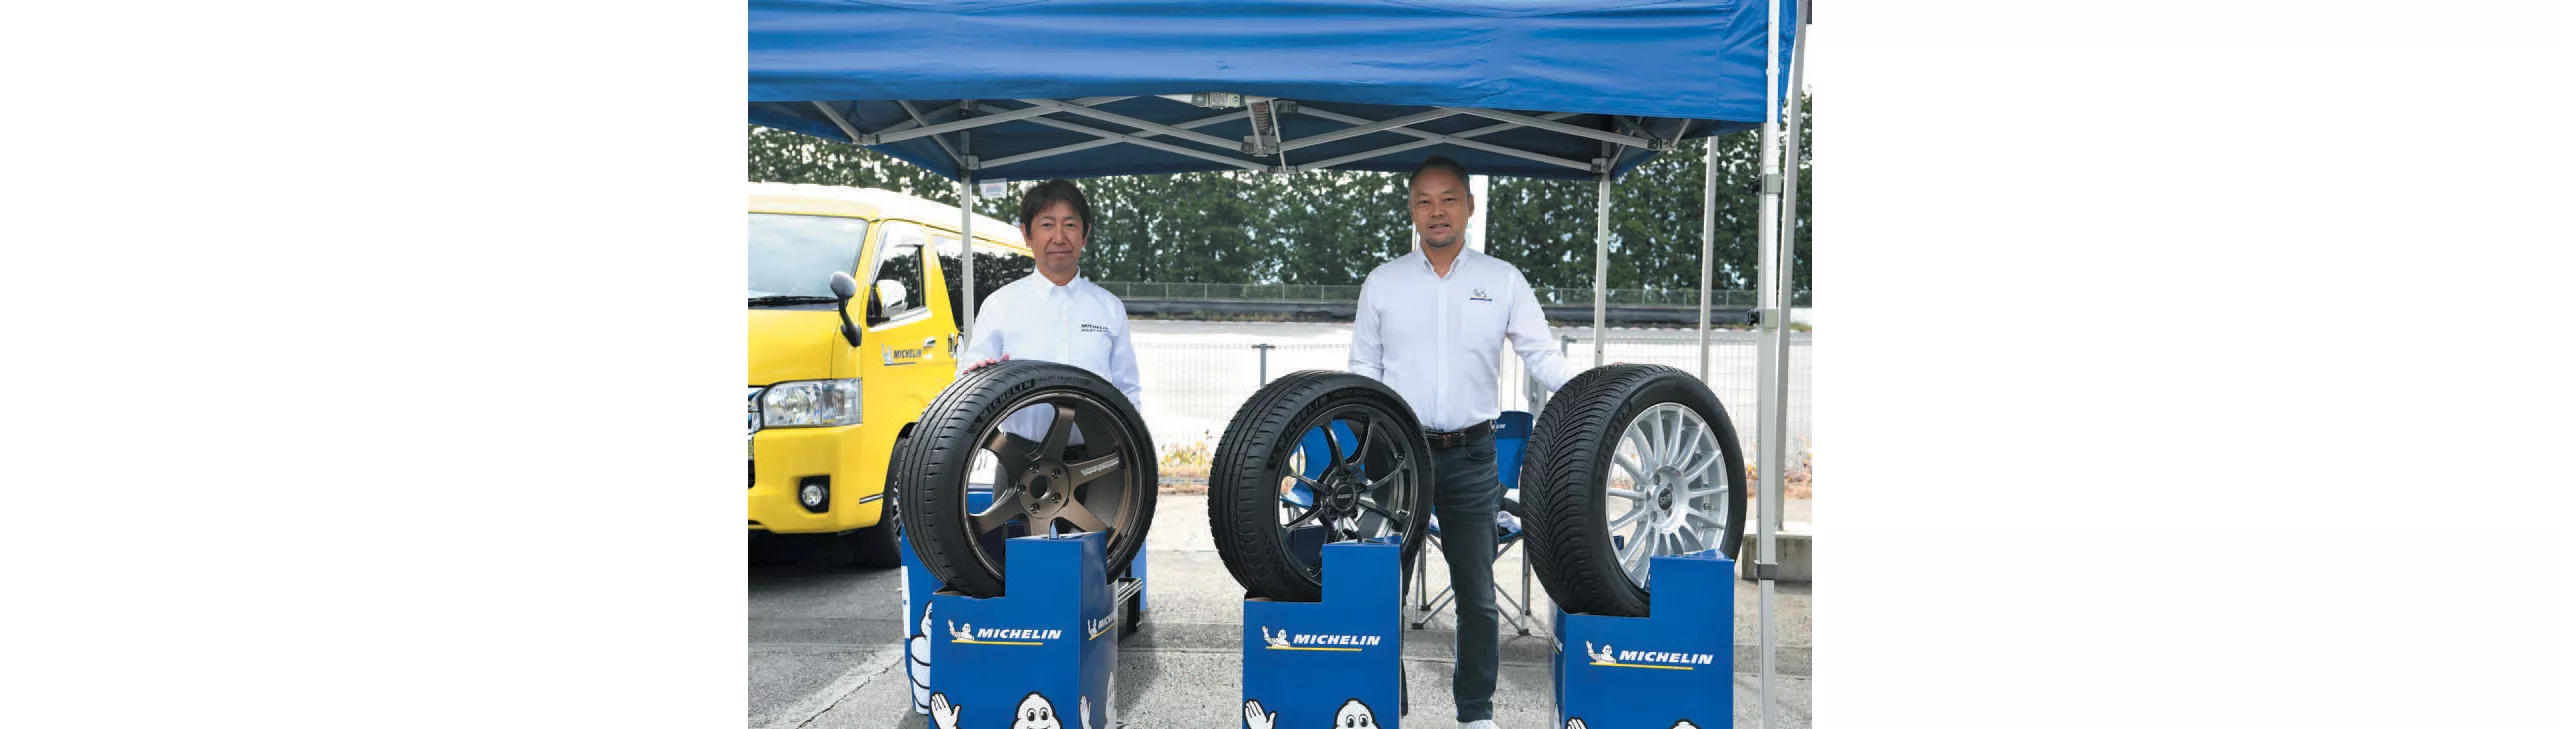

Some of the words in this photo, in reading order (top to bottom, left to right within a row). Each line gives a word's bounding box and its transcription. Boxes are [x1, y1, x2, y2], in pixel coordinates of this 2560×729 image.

[893, 348, 922, 358] MICHELIN
[977, 628, 1062, 640] MICHELIN
[1293, 634, 1381, 645] MICHELIN
[1619, 650, 1714, 664] MICHELIN
